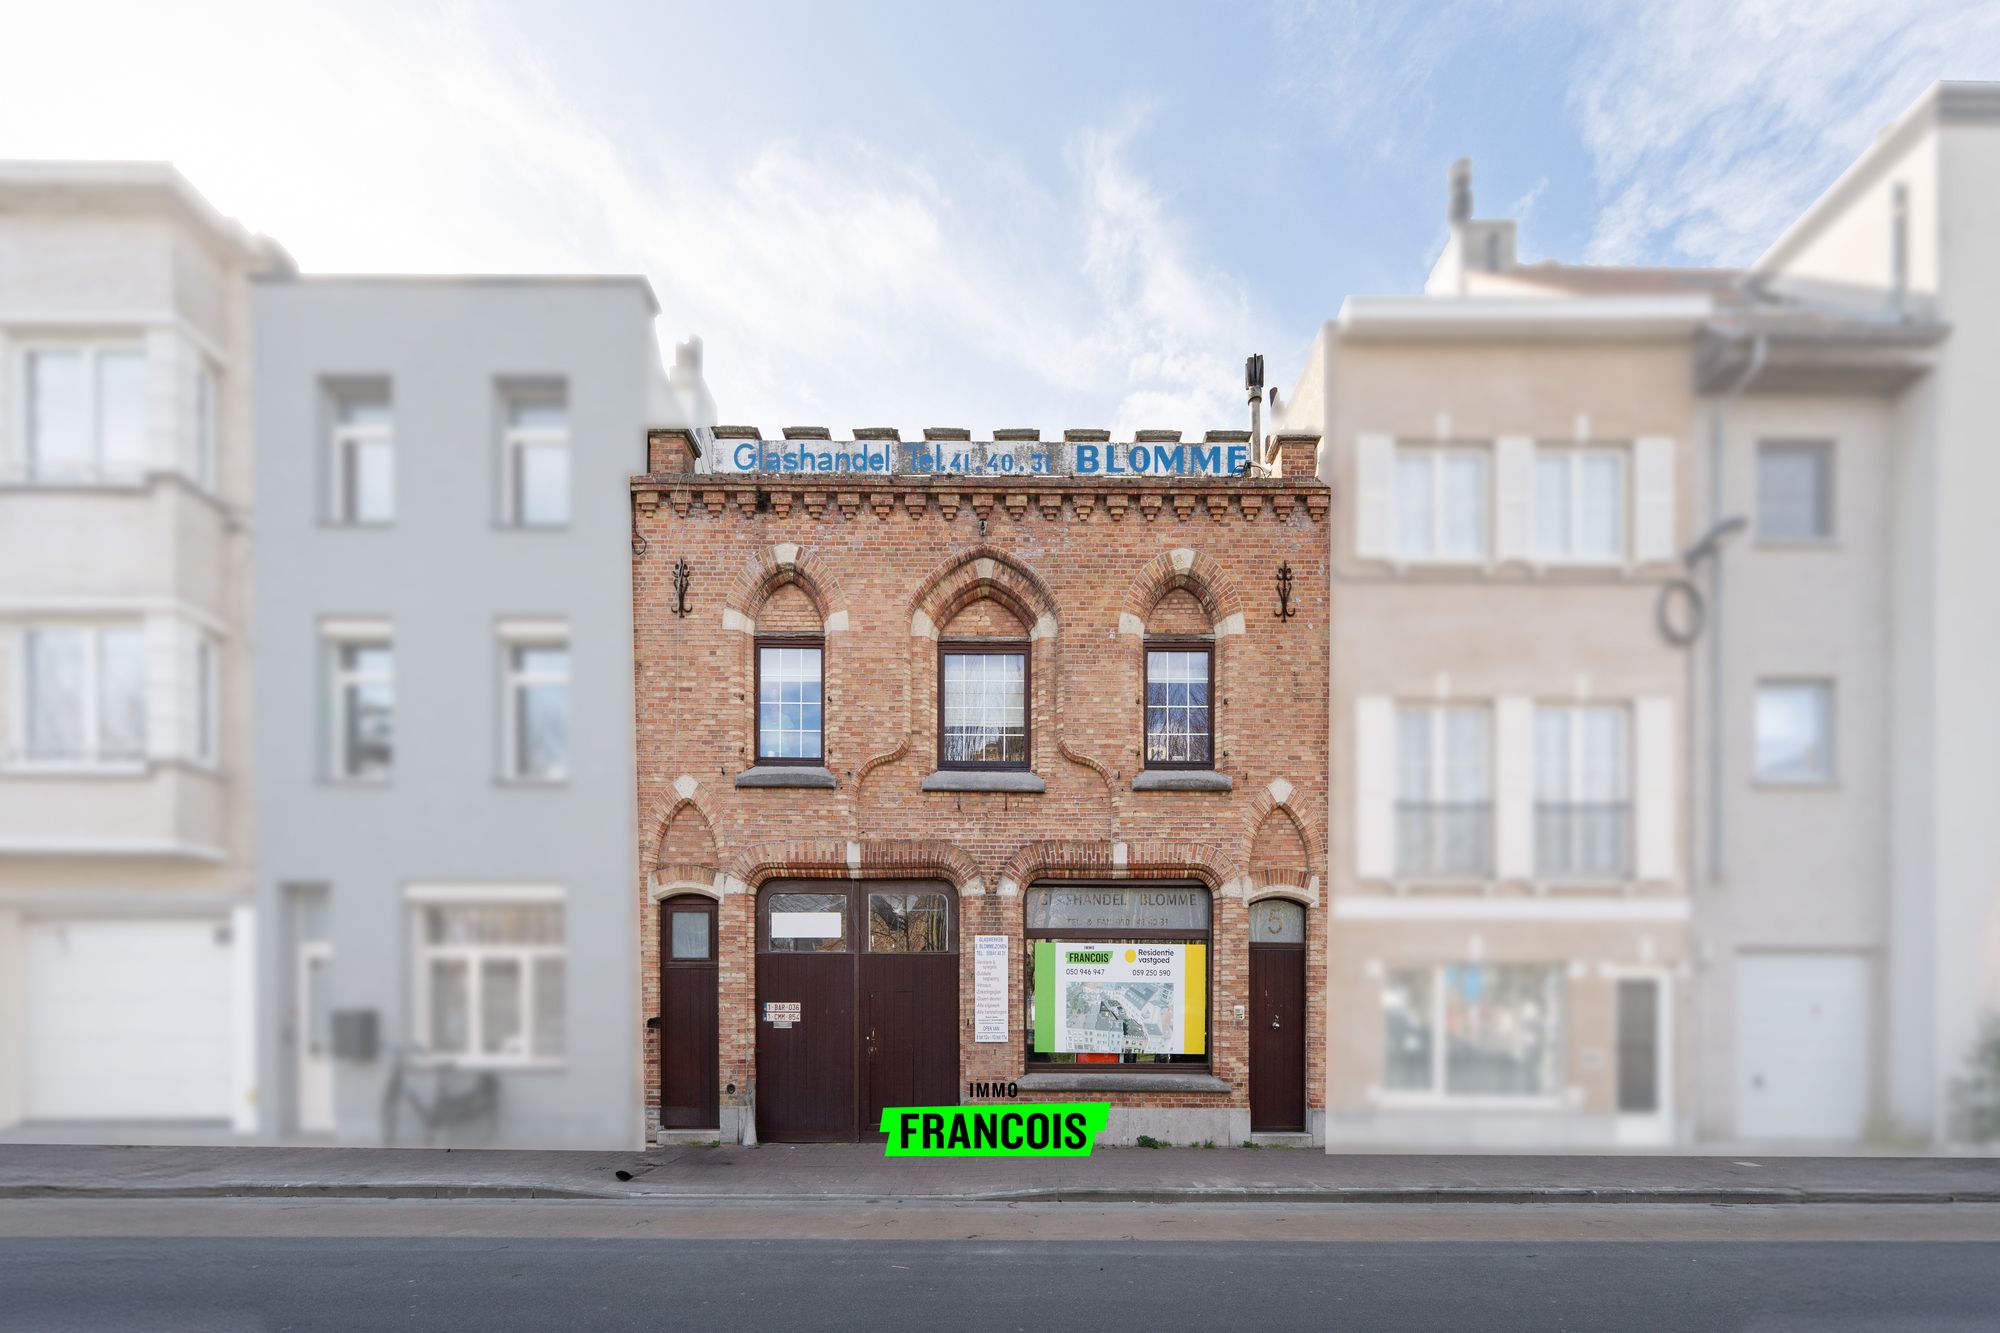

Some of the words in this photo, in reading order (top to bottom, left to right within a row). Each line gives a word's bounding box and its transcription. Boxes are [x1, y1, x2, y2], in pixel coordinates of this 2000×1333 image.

[733, 443, 890, 471] Glashandel
[1076, 445, 1247, 474] BLOMME
[1140, 893, 1198, 906] BLOMME
[1268, 908, 1283, 935] 5
[1069, 952, 1109, 963] FRANCOIS
[1138, 949, 1174, 957] Residentie
[1138, 956, 1170, 965] vastgoed
[1066, 968, 1078, 976] 050
[1079, 968, 1092, 976] 946
[1093, 968, 1105, 976] 947
[1132, 969, 1144, 977] 059
[1145, 969, 1158, 977] 250
[1159, 969, 1171, 977] 590
